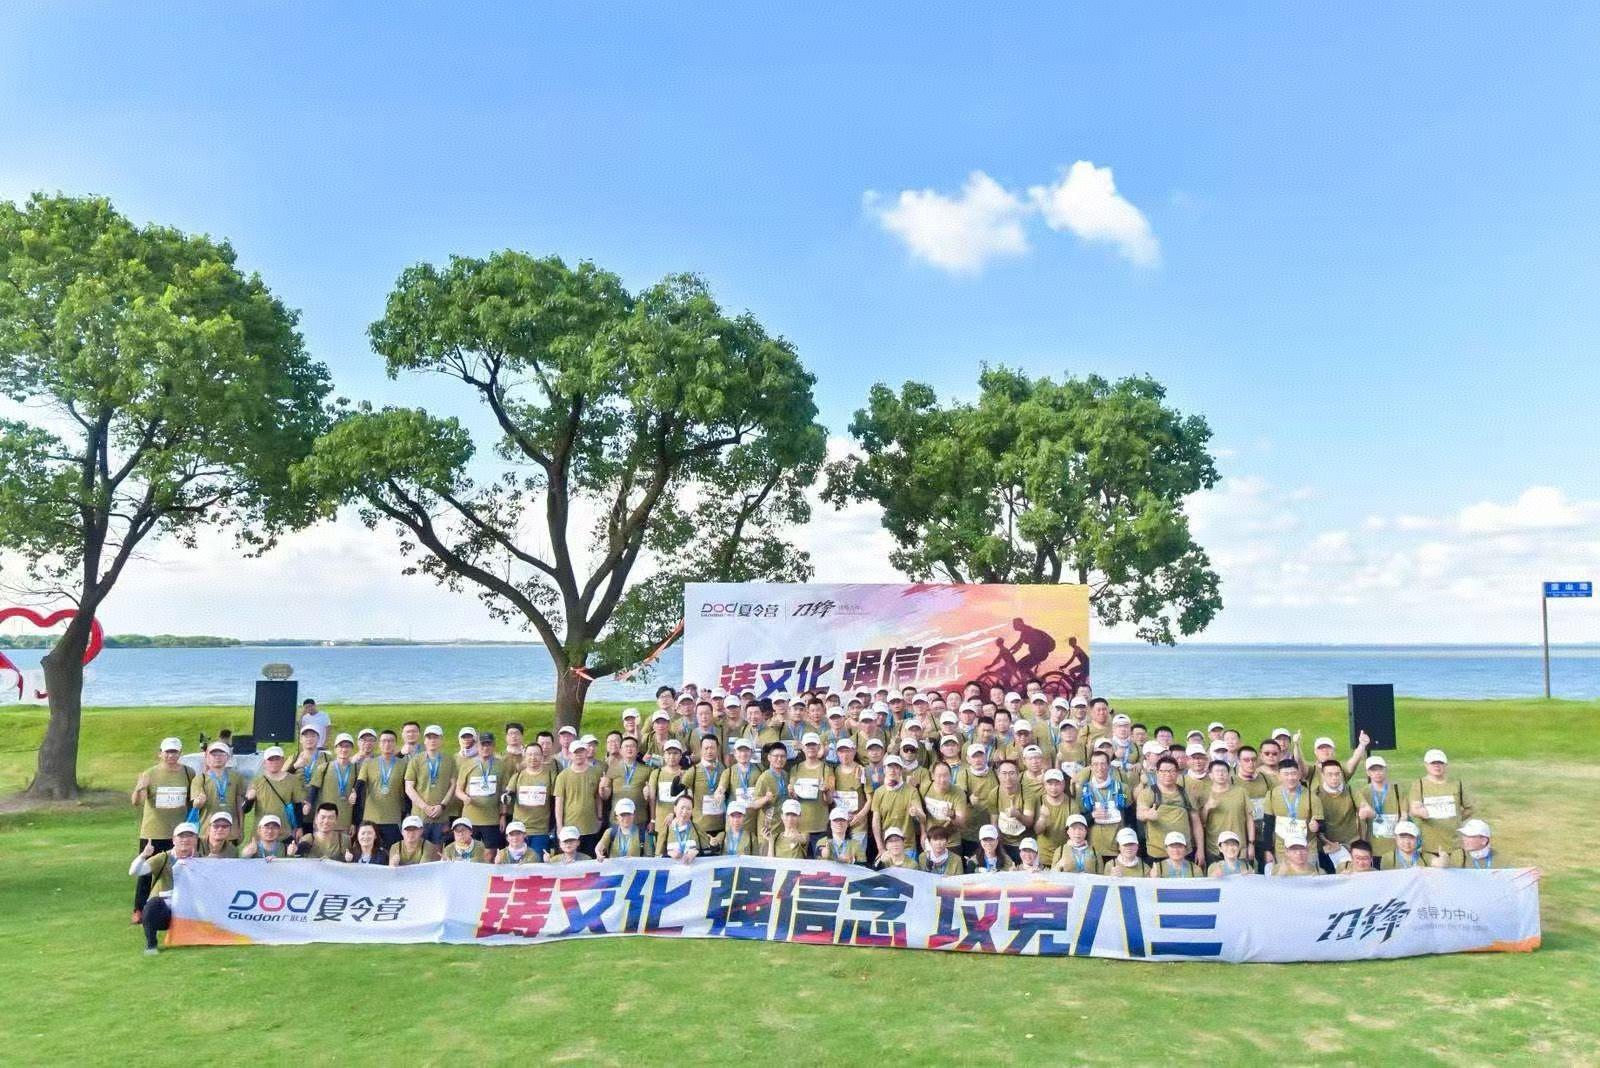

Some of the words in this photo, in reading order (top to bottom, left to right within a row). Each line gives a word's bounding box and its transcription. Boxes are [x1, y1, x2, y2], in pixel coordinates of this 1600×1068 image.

[313, 893, 408, 922] 夏令营
[474, 869, 692, 938] 铸文化
[705, 866, 914, 949] 强信念
[926, 883, 1223, 957] 攻克八三
